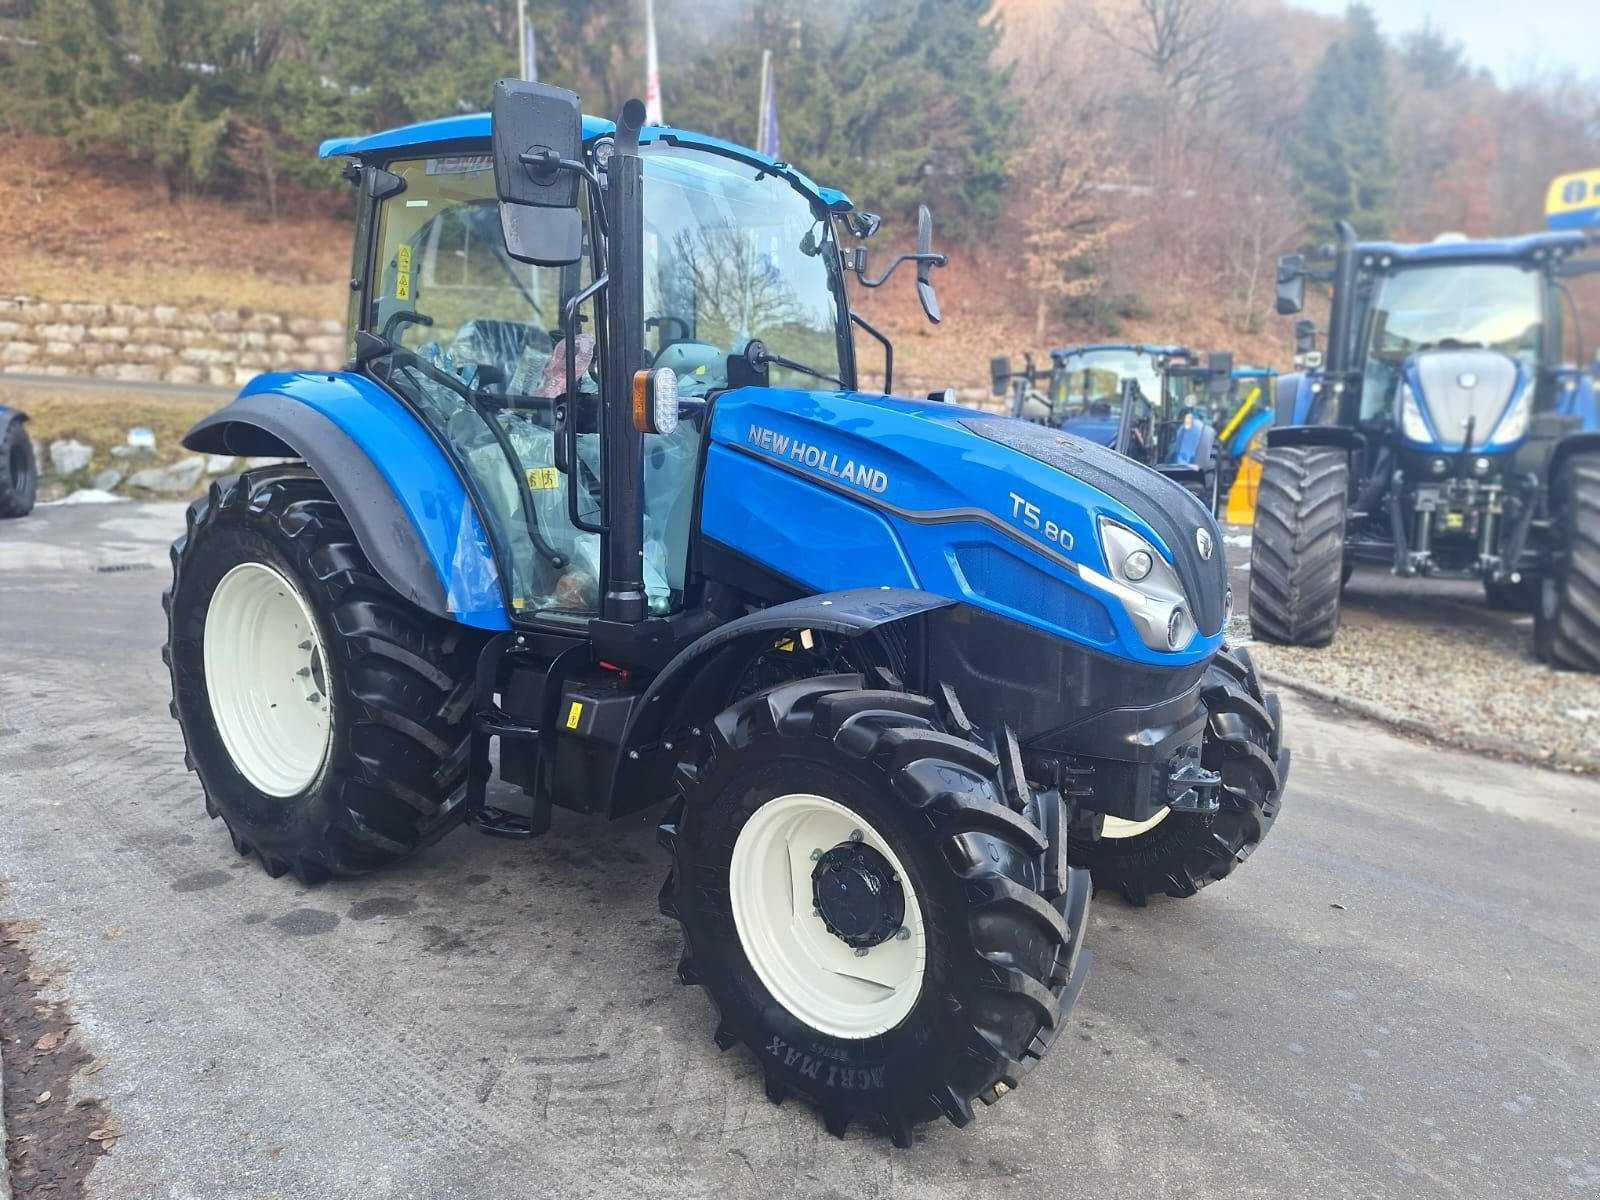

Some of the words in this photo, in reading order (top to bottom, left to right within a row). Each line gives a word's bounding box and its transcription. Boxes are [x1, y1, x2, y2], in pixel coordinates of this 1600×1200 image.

[748, 424, 789, 455] NEW
[789, 439, 888, 493] HOLLAND
[1009, 491, 1074, 551] T5.80
